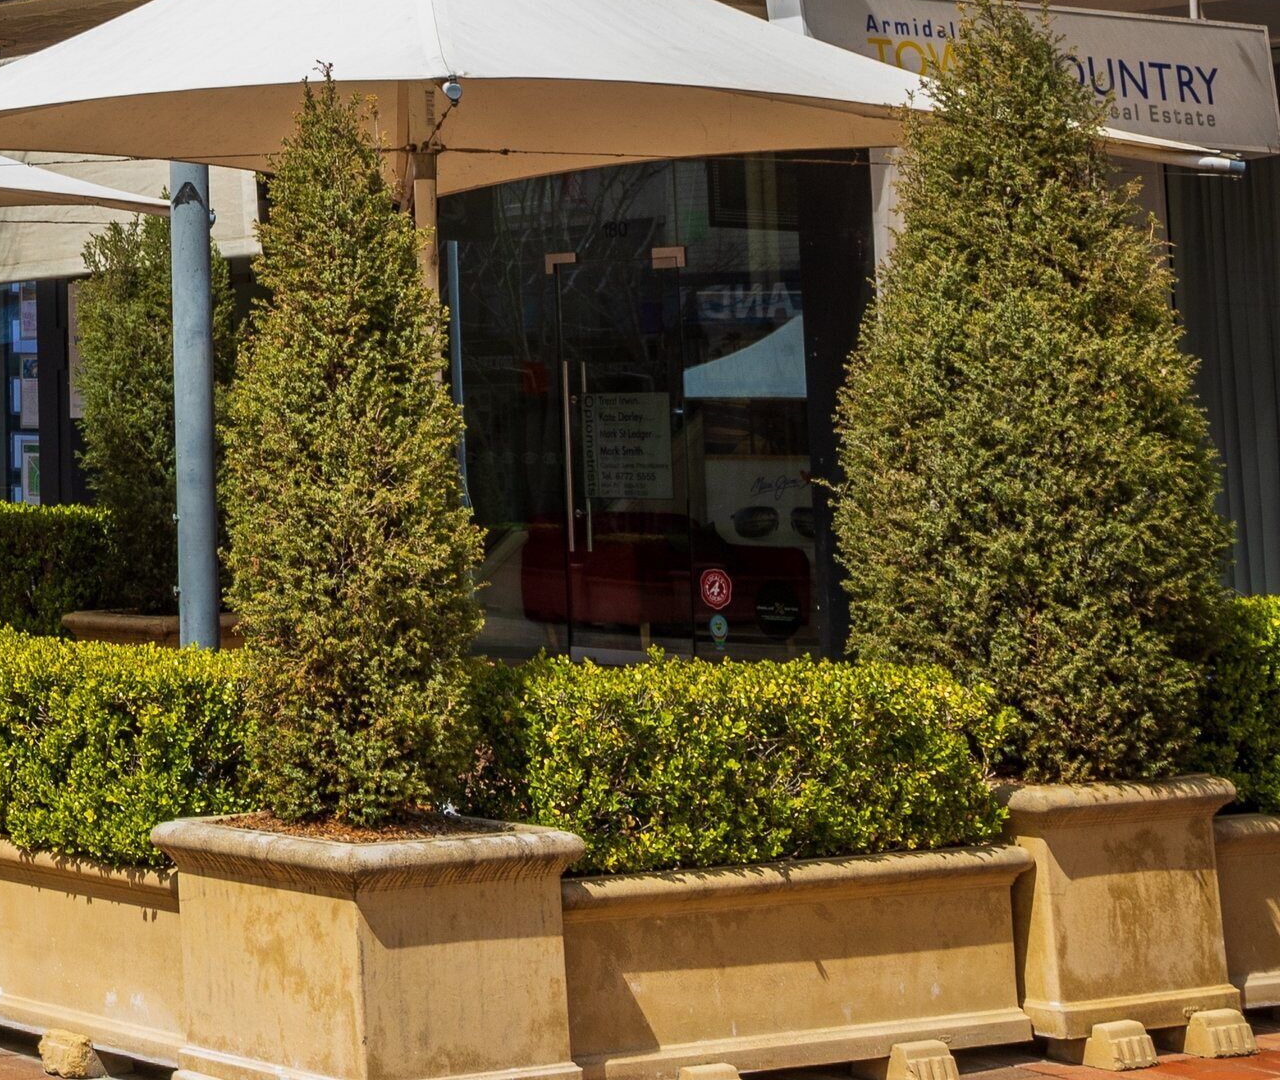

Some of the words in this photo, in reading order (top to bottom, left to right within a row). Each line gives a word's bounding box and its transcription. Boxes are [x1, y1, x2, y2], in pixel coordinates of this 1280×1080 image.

[866, 14, 956, 39] Armidal
[867, 37, 964, 77] TOW
[1057, 54, 1218, 105] OUNTRY
[1149, 104, 1216, 128] Estate
[603, 222, 627, 238] 180
[585, 395, 597, 496] Optometrists
[709, 580, 721, 597] 4
